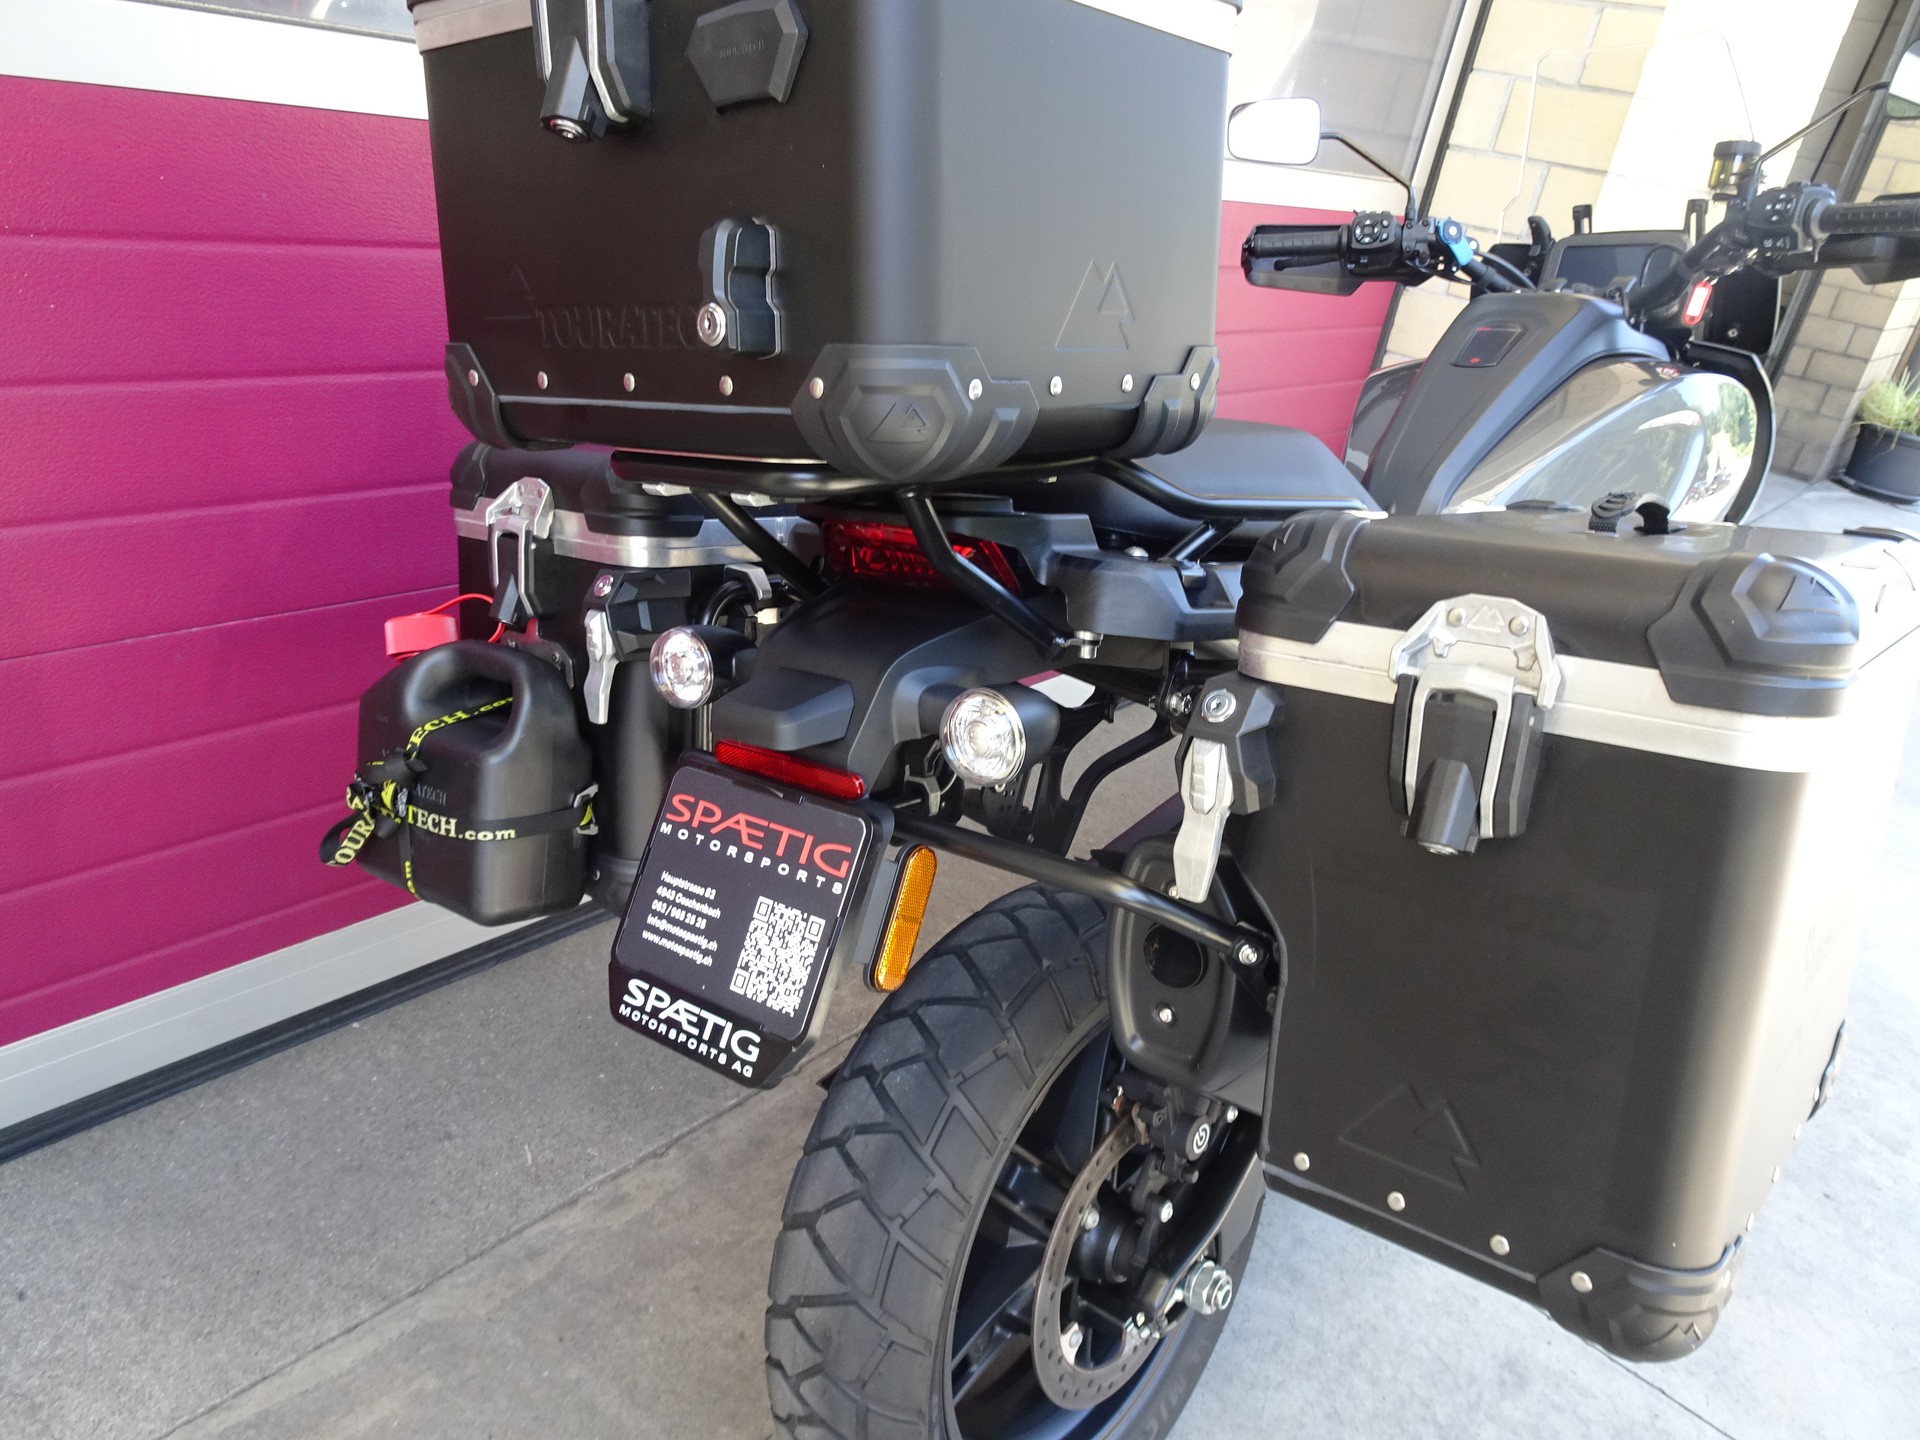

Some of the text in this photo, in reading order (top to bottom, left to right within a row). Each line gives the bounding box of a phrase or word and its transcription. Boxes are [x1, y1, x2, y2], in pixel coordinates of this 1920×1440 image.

[534, 305, 699, 350] TOURATEC
[660, 821, 843, 895] MOTORSPORTS
[661, 870, 705, 896] Hauptstrasse
[619, 1003, 754, 1078] MOTORSPORTS AG
